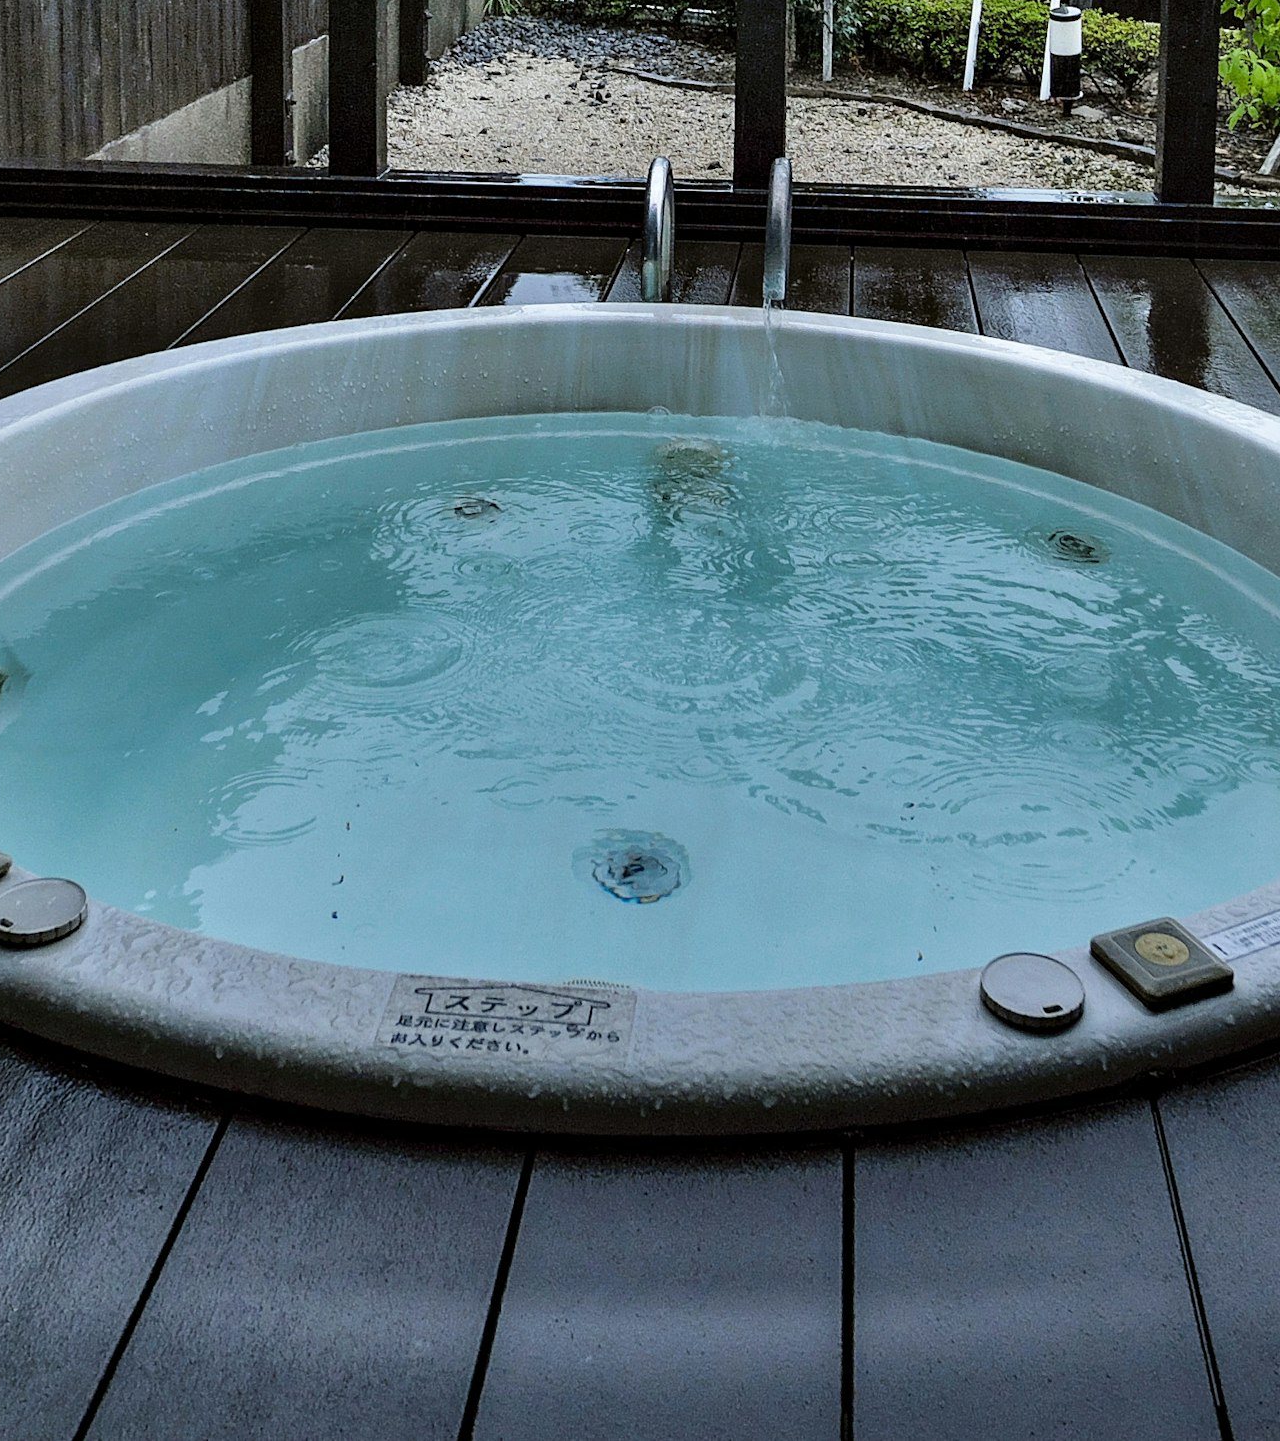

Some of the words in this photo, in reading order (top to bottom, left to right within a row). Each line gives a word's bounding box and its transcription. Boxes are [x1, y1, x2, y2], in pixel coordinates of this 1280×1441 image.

[445, 994, 583, 1019] ステップ
[394, 1014, 621, 1043] 足元に注意しステップから
[389, 1032, 529, 1055] お入りください。
